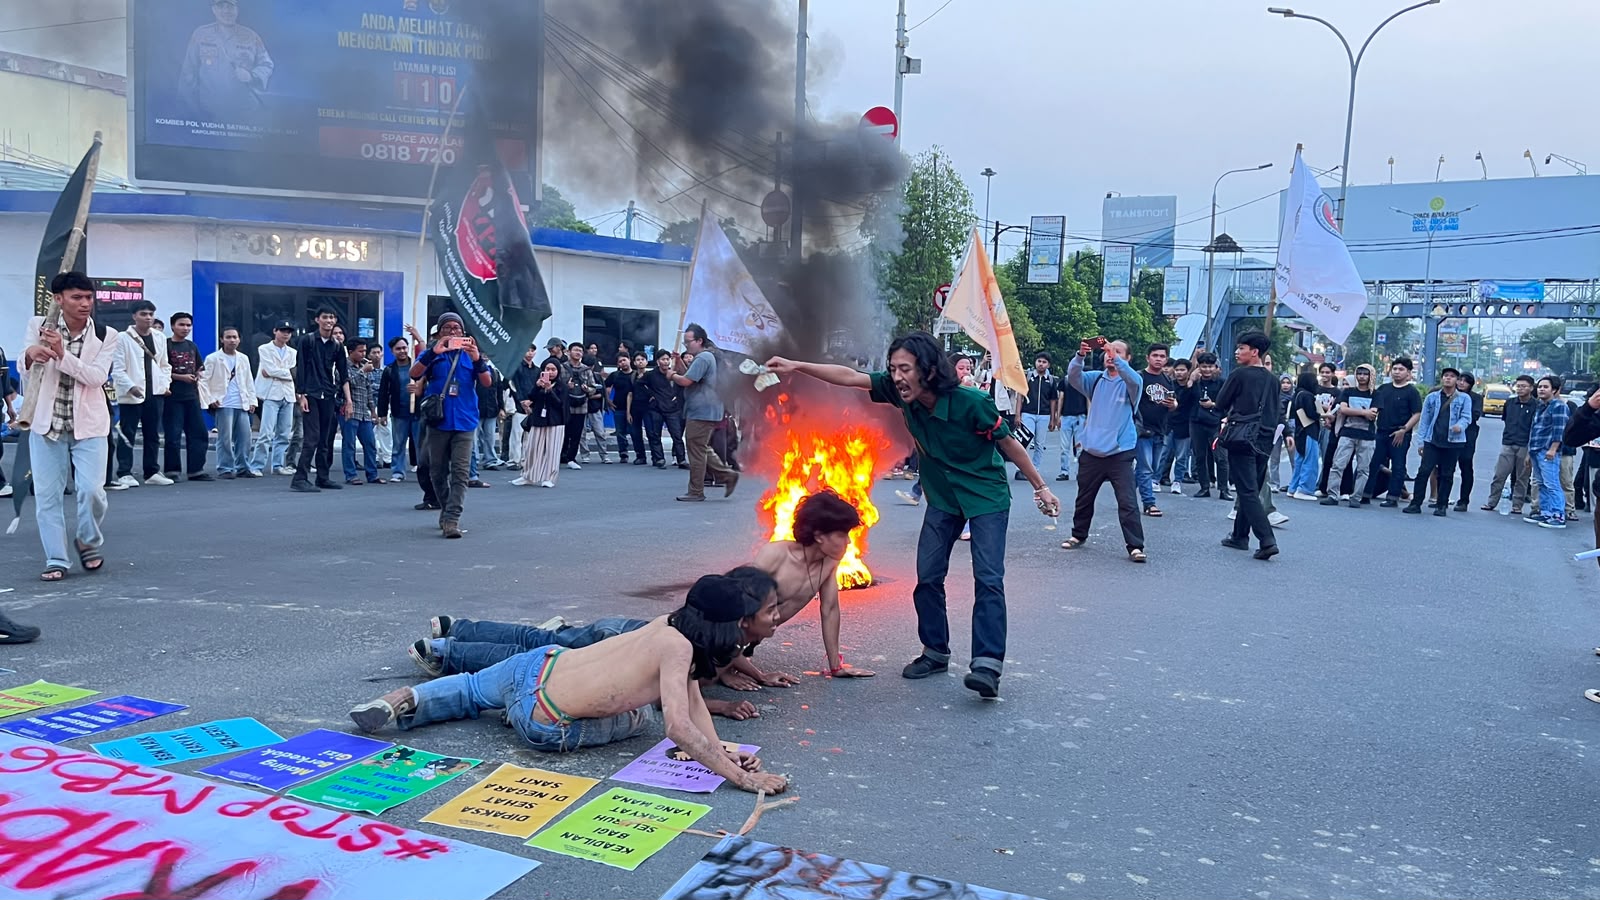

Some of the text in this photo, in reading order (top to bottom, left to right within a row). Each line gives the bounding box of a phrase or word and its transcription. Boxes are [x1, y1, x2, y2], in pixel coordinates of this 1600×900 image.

[361, 13, 396, 32] ANDA
[398, 17, 454, 36] MELIHAT
[337, 31, 497, 61] MENGALAMI TINDAK PIDA
[401, 78, 452, 105] 110
[185, 120, 200, 128] POL
[381, 133, 417, 144] SPACE
[361, 143, 456, 165] 0818 720
[1110, 208, 1169, 218] TRANSmart
[232, 232, 281, 256] POS
[1133, 256, 1148, 265] UK
[1323, 297, 1342, 313] Studi
[466, 287, 494, 324] PROGRAM
[491, 321, 512, 344] STUDI
[479, 320, 500, 346] ISLAM
[261, 748, 335, 768] Berkedok
[318, 749, 353, 761] Gizi
[259, 759, 315, 776] Maling
[684, 765, 722, 777] ENAPA
[515, 777, 563, 789] SAKIT
[484, 783, 570, 802] DI NEGARA
[481, 796, 538, 810] SEHAT
[611, 794, 693, 817] YANG MANA
[460, 805, 531, 823] DIPAKSA
[610, 806, 669, 823] RAKYAT
[592, 827, 631, 840] BAGI
[560, 831, 635, 855] KEADILAN
